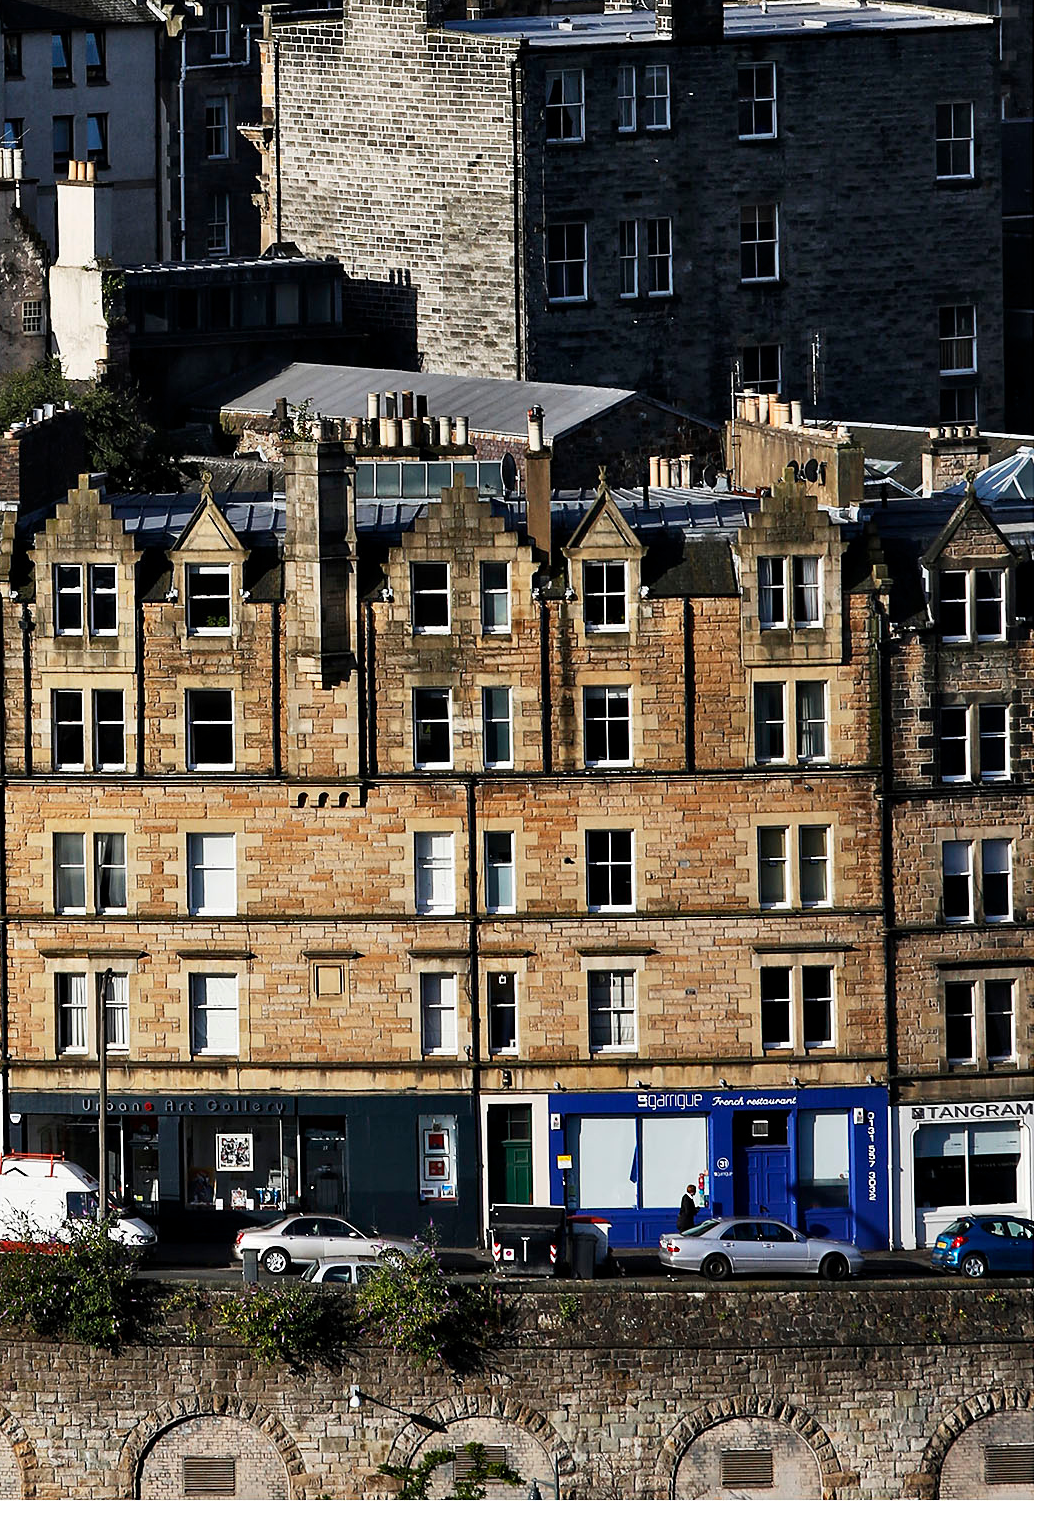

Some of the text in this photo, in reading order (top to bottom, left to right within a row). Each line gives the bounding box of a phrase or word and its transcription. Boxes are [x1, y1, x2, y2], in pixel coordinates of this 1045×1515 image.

[164, 1099, 195, 1112] Art
[207, 1100, 284, 1115] Gallery
[648, 1093, 703, 1111] garrigue
[712, 1096, 797, 1106] French restaurant
[927, 1102, 1034, 1119] TANGRAM
[867, 1111, 876, 1142] 0131
